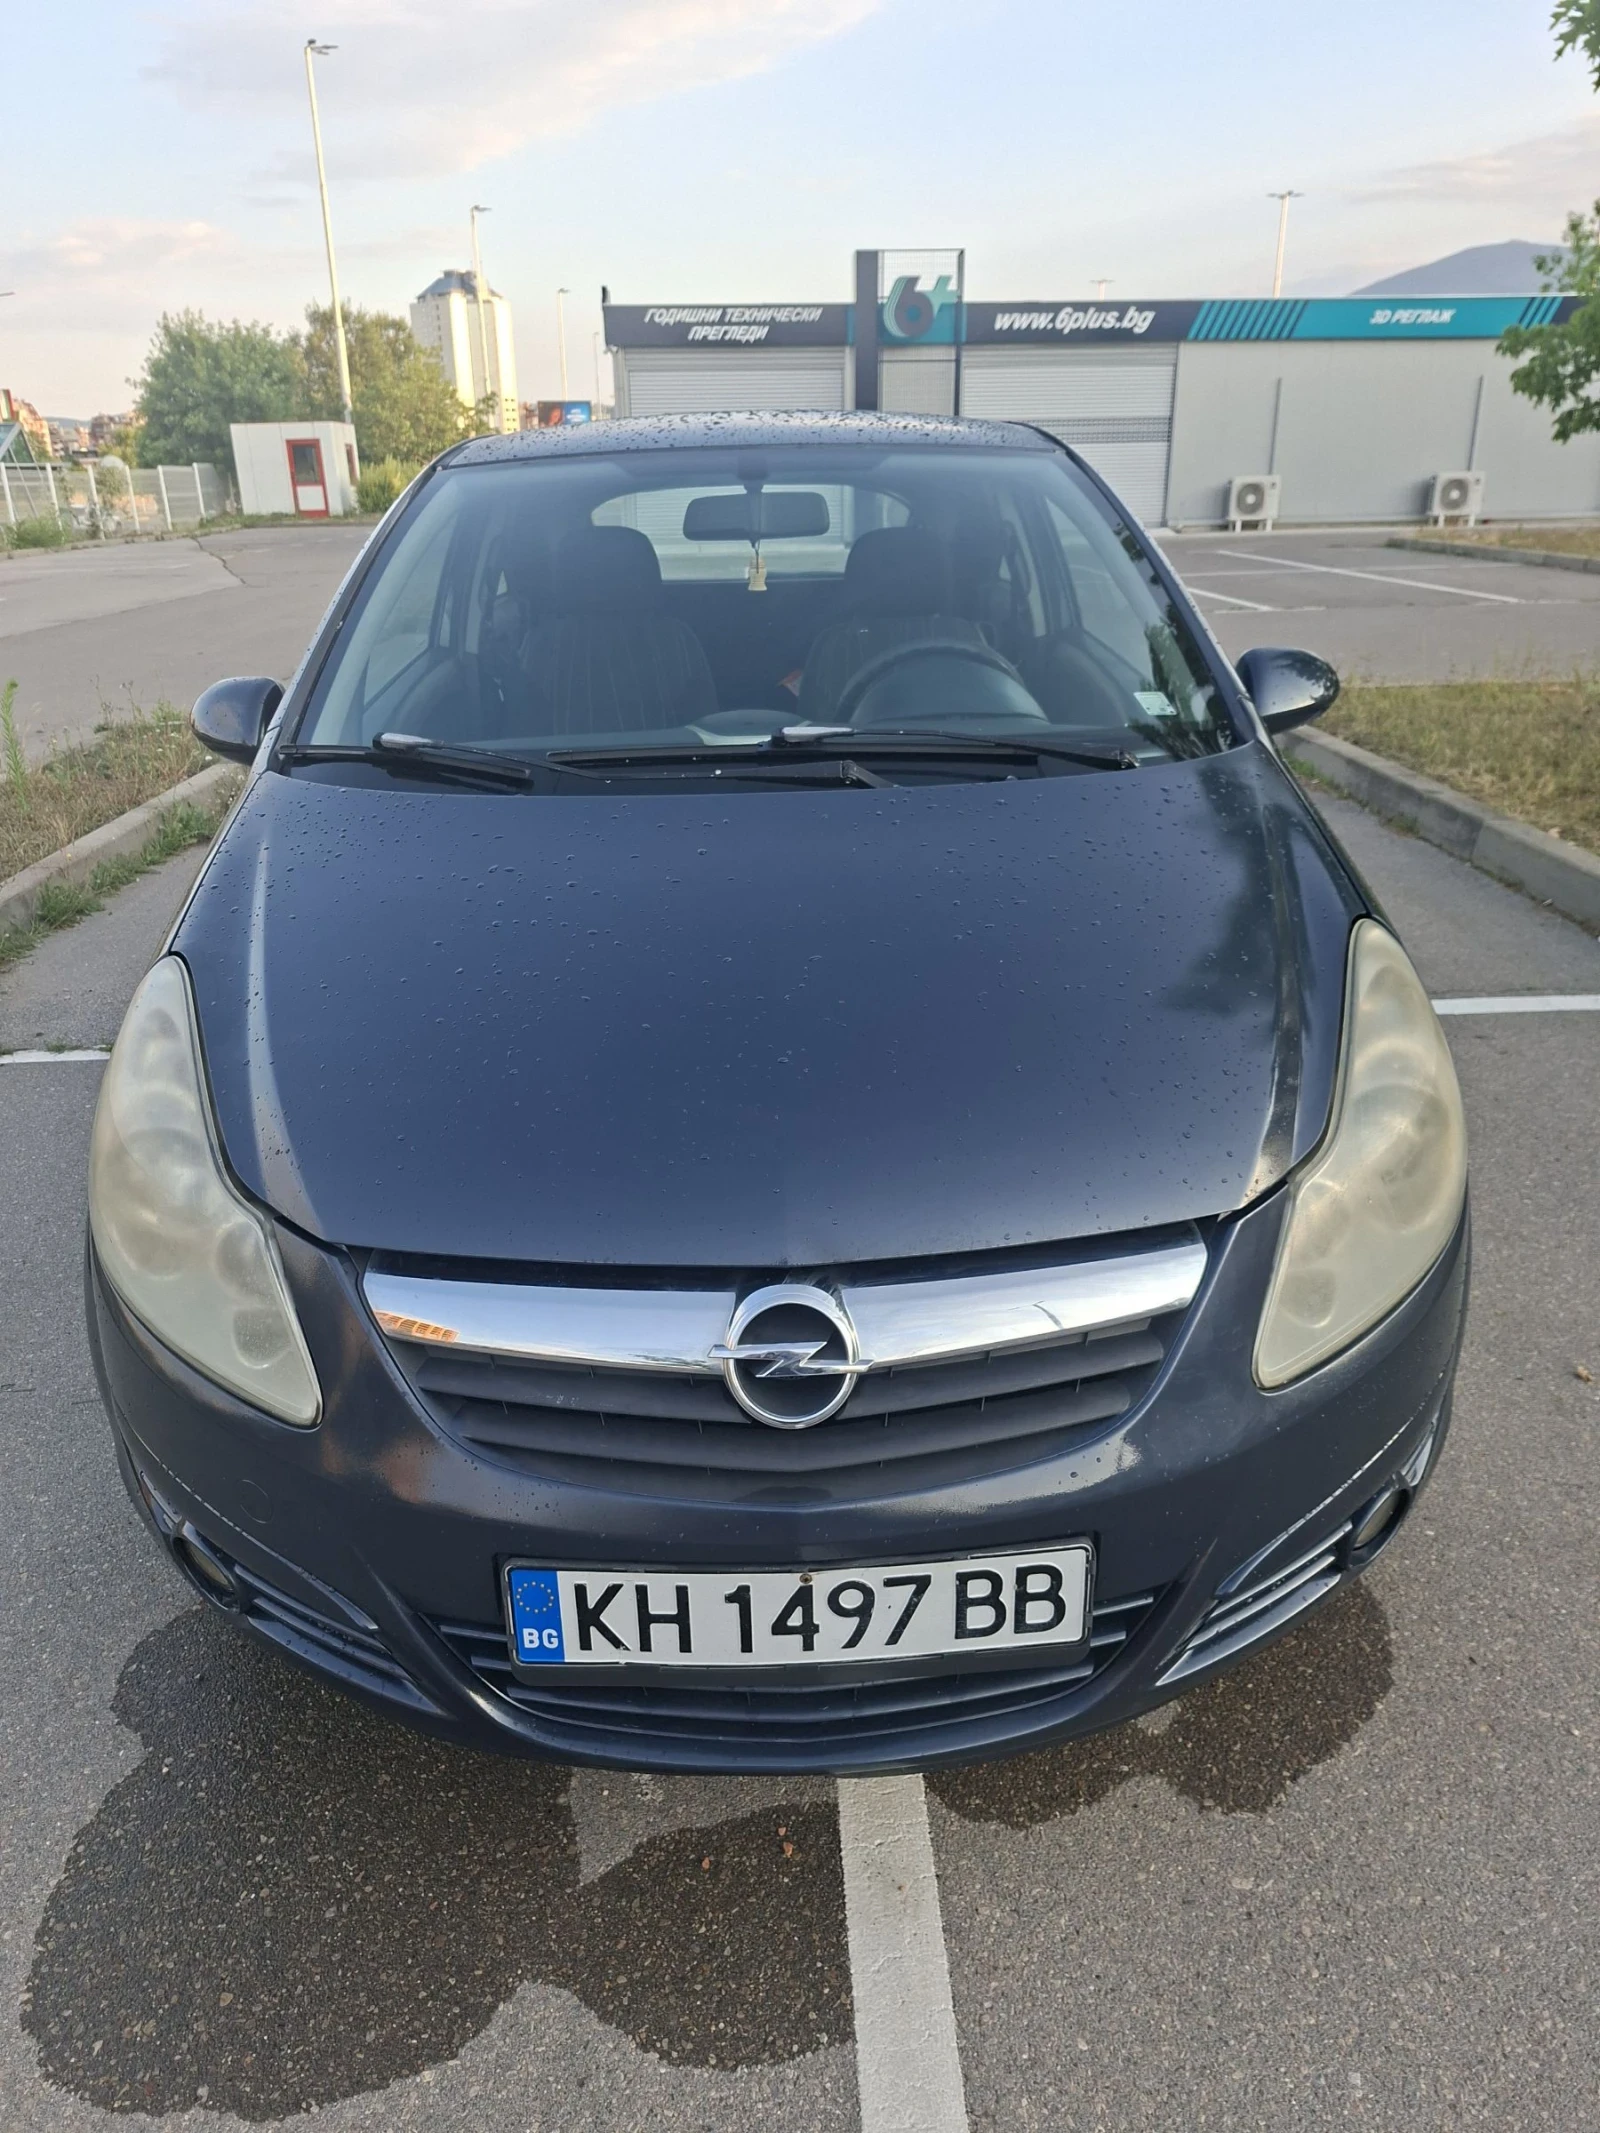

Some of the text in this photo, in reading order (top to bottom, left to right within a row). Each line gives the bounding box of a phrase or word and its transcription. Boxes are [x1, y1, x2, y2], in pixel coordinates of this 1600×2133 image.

[644, 307, 823, 326] ГОДИШНИ ТЕХНИЧЕСКИ
[994, 306, 1156, 335] www.6plus.bg
[1390, 308, 1457, 324] РЕГЛАЖ
[687, 325, 770, 343] ПРЕГЛЕДИ
[574, 1564, 1066, 1653] KH 1497 BB
[522, 1628, 559, 1649] BG
